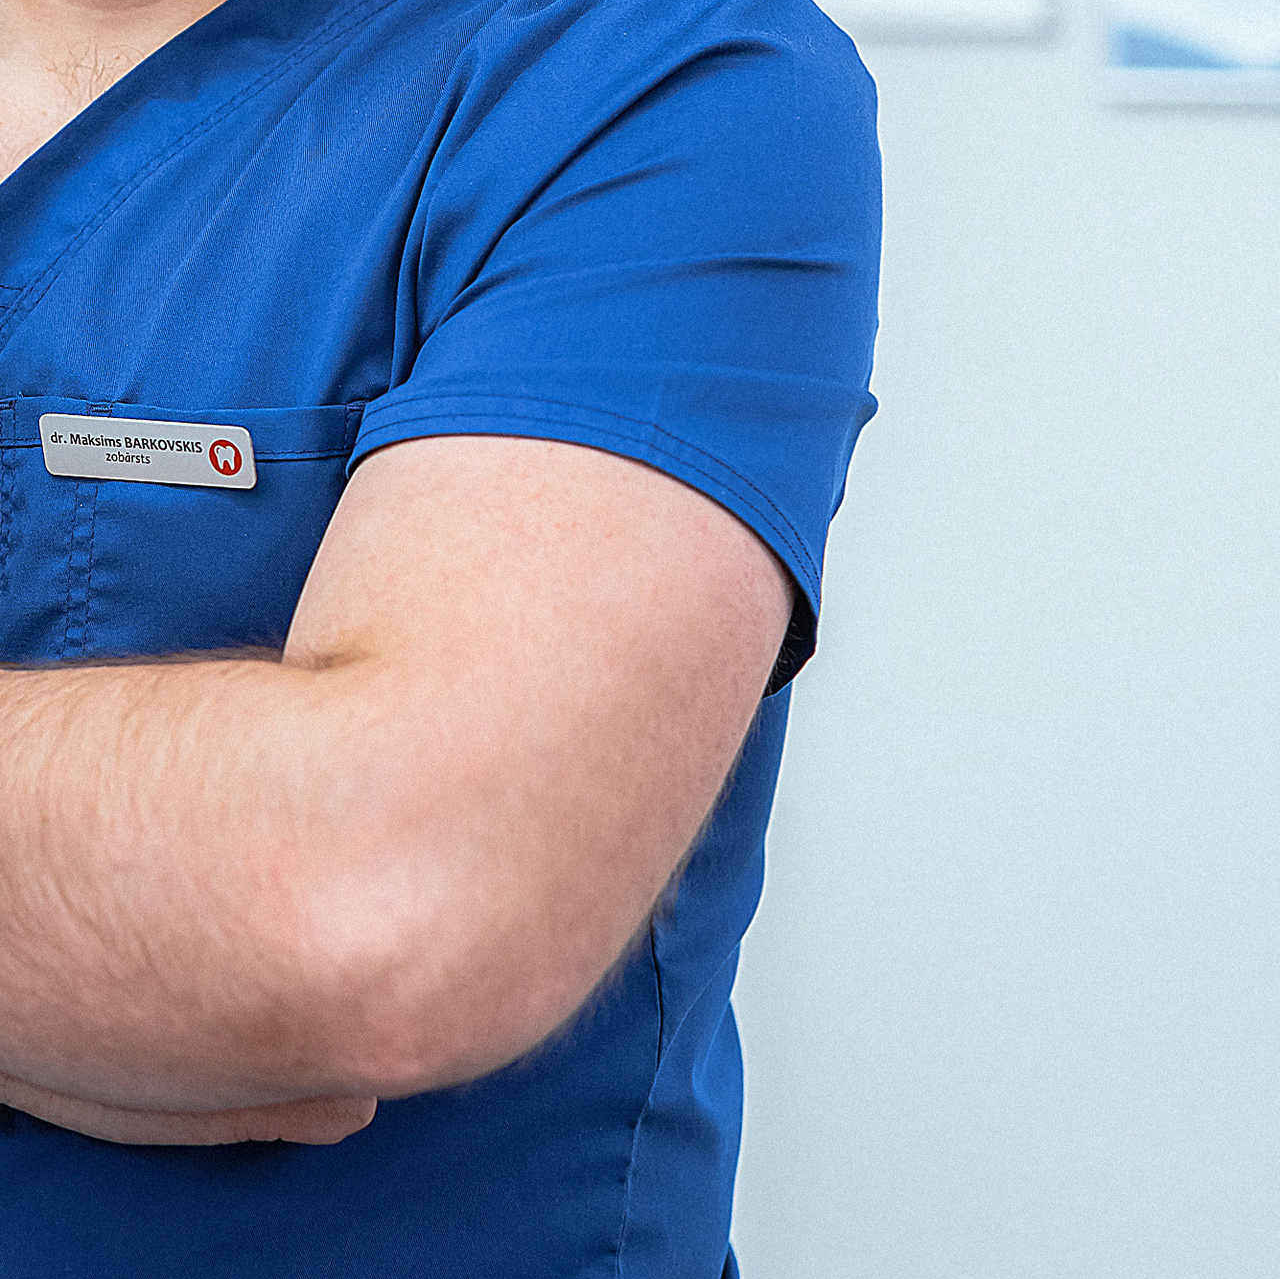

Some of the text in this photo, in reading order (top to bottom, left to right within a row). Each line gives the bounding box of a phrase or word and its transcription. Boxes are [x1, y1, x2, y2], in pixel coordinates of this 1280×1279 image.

[50, 431, 203, 453] dr. Maksims BARKOVSKIS
[106, 452, 151, 464] zobārsts
